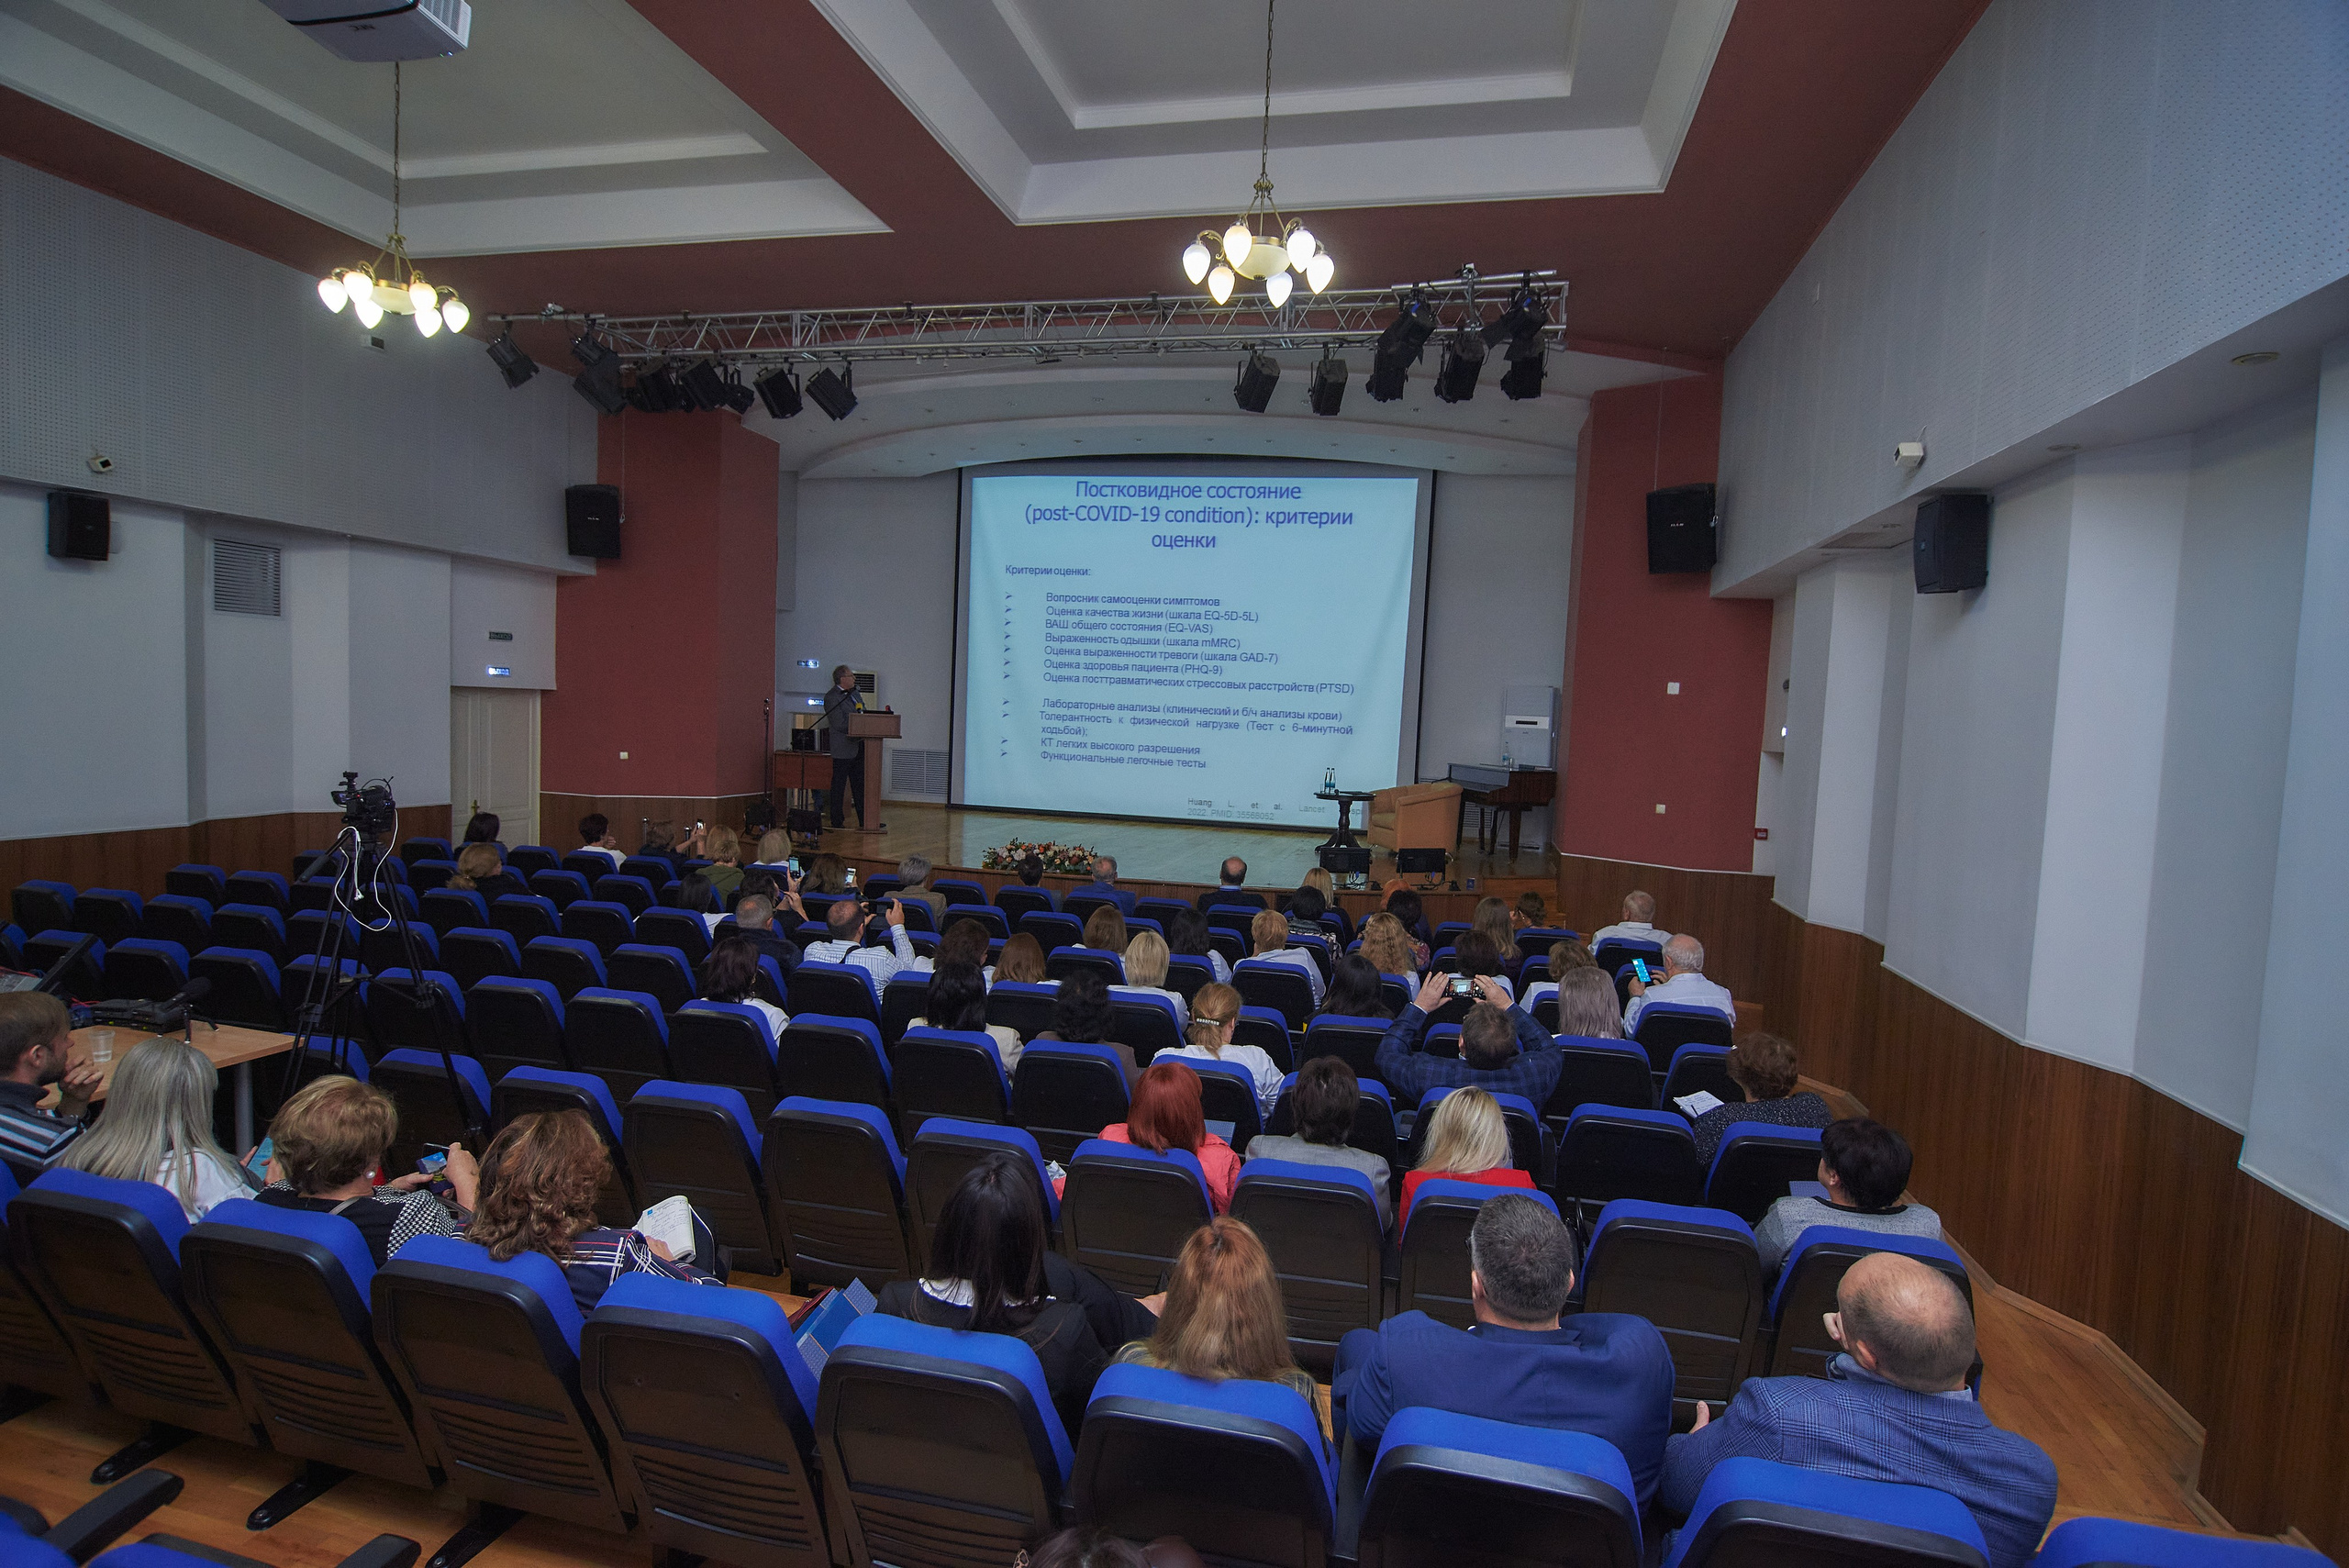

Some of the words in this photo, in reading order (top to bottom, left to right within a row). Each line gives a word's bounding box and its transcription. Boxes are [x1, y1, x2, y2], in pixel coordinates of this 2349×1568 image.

[1075, 480, 1202, 500] Постковидное
[1207, 485, 1302, 500] состояние
[1025, 504, 1161, 525] (post-COVID-19
[1164, 506, 1259, 528] condition):
[1265, 510, 1353, 529] критерии
[1151, 534, 1217, 550] оценки
[1005, 564, 1052, 577] Критерии
[1053, 567, 1092, 578] оценки:
[1045, 592, 1099, 605] Вопросник
[1100, 595, 1162, 606] самооценки
[1162, 596, 1221, 606] симптомов
[1045, 606, 1084, 617] Оценка
[1085, 608, 1130, 618] качества
[1131, 610, 1164, 619] жизни
[1164, 609, 1203, 621] (шкала
[1203, 610, 1260, 623] EQ-5D-5L)
[1044, 618, 1070, 629] ВАШ
[1071, 619, 1108, 631] общего
[1109, 622, 1163, 632] состояния
[1164, 622, 1214, 635] (EQ-VAS)
[1044, 632, 1120, 645] Выраженность
[1119, 636, 1162, 646] одышки
[1162, 637, 1200, 648] (шкала
[1200, 638, 1241, 650] mMRC)
[1043, 645, 1082, 657] Оценка
[1083, 648, 1158, 660] выраженности
[1158, 651, 1199, 661] тревоги
[1199, 651, 1238, 662] (шкала
[1239, 651, 1279, 665] GAD-7)
[1042, 659, 1081, 671] Оценка
[1082, 662, 1130, 673] здоровья
[1130, 663, 1180, 674] пациента
[1180, 663, 1223, 677] (PHQ-9)
[1042, 672, 1081, 684] Оценка
[1081, 674, 1186, 687] посттравматических
[1186, 679, 1248, 690] стрессовых
[1247, 682, 1317, 694] расстройств
[1315, 683, 1355, 695] (PTSD)
[1041, 697, 1116, 711] Лабораторные
[1116, 702, 1162, 713] анализы
[1162, 703, 1232, 716] (клинический
[1231, 707, 1240, 717] и
[1241, 706, 1258, 717] б/ч
[1259, 709, 1306, 719] анализы
[1307, 710, 1343, 723] крови)
[1039, 710, 1113, 724] Толерантность
[1118, 715, 1125, 724] к
[1129, 716, 1190, 727] физической
[1195, 719, 1241, 731] нагрузке
[1245, 719, 1275, 732] (Тест
[1278, 722, 1286, 732] с
[1291, 722, 1354, 736] 6-минутной
[1040, 725, 1089, 737] ходьбой);
[1040, 737, 1055, 748] КТ
[1055, 740, 1088, 750] легких
[1089, 741, 1136, 751] высокого
[1137, 743, 1201, 755] разрешения
[1040, 751, 1126, 765] Функциональные
[1126, 756, 1174, 767] легочные
[1175, 759, 1208, 769] тесты
[1187, 797, 1213, 808] Huang
[1227, 800, 1235, 808] L.
[1273, 803, 1283, 811] al.
[1298, 804, 1326, 814] Lancet
